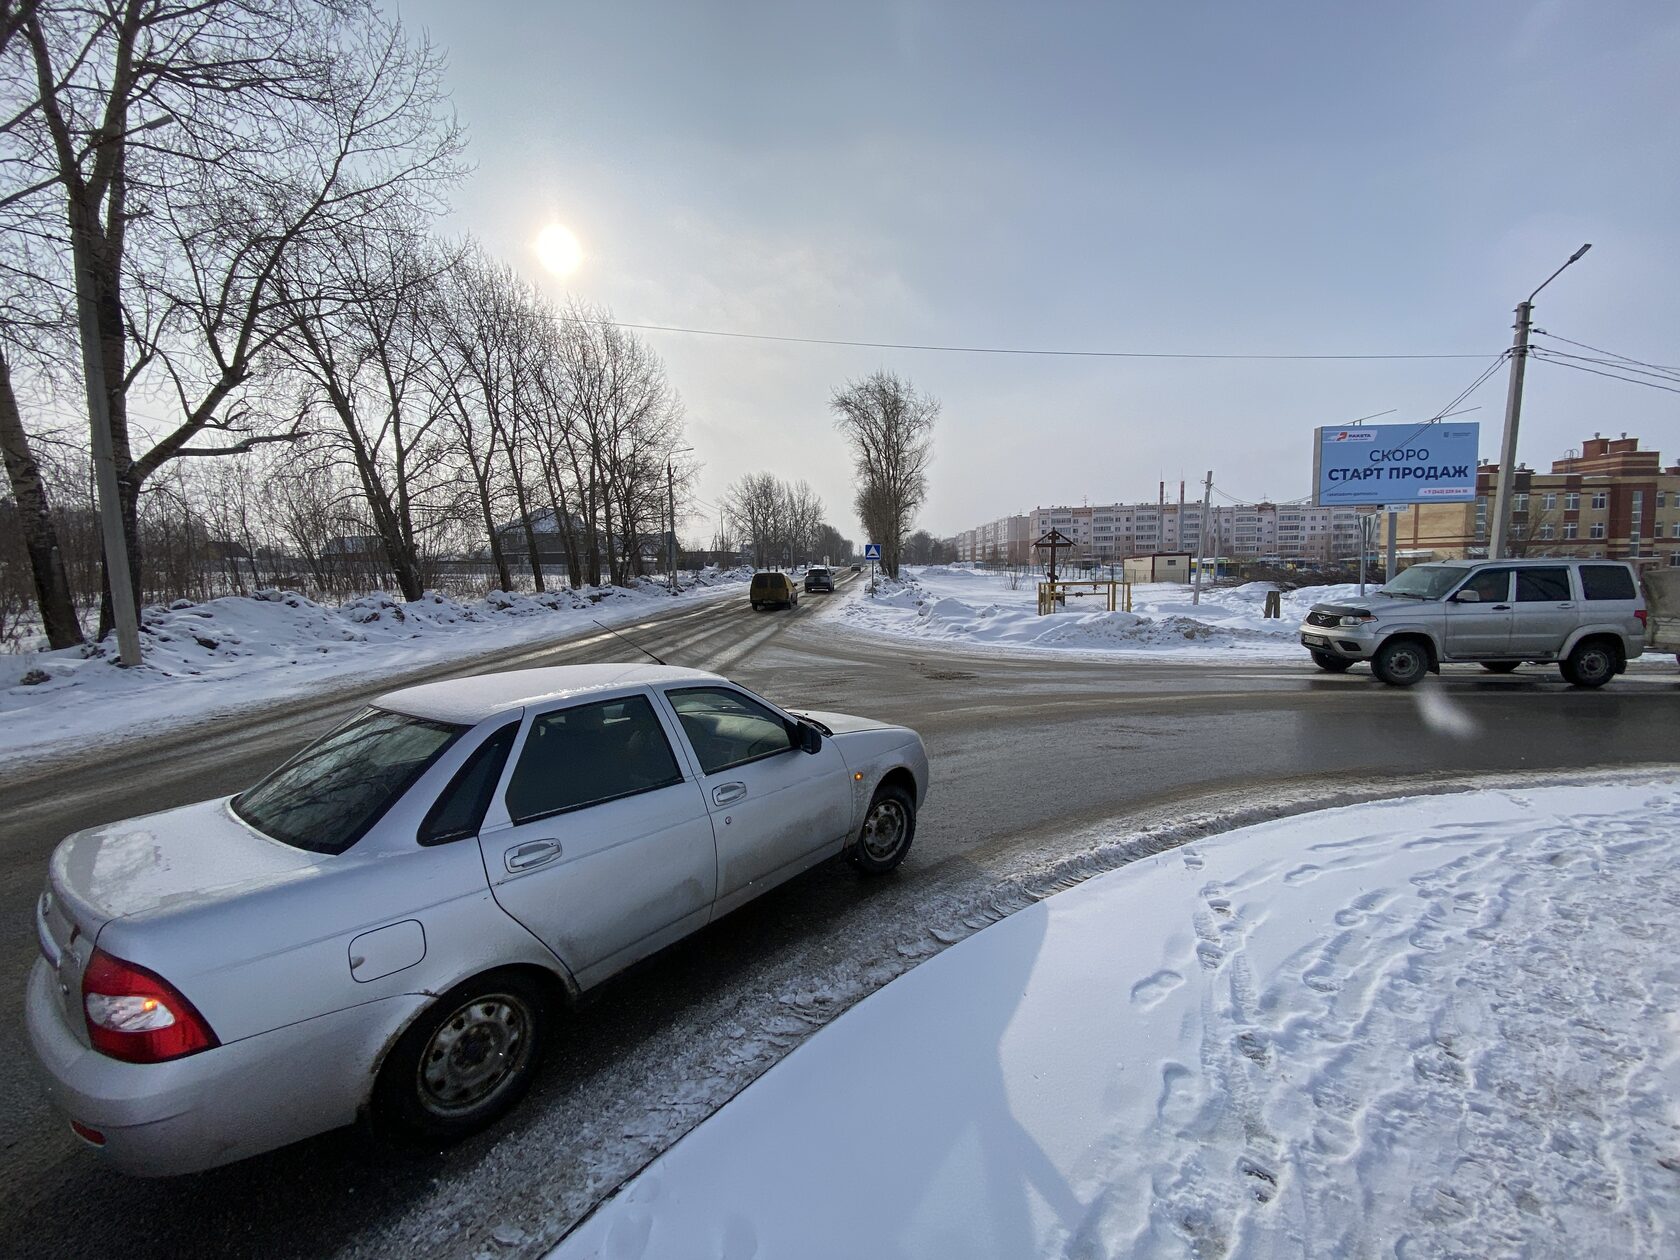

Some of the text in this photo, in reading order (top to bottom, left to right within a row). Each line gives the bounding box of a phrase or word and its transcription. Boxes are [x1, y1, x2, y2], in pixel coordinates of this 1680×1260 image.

[1369, 448, 1429, 462] СКОРО
[1328, 465, 1469, 481] СТАРТ ПРОДАЖ
